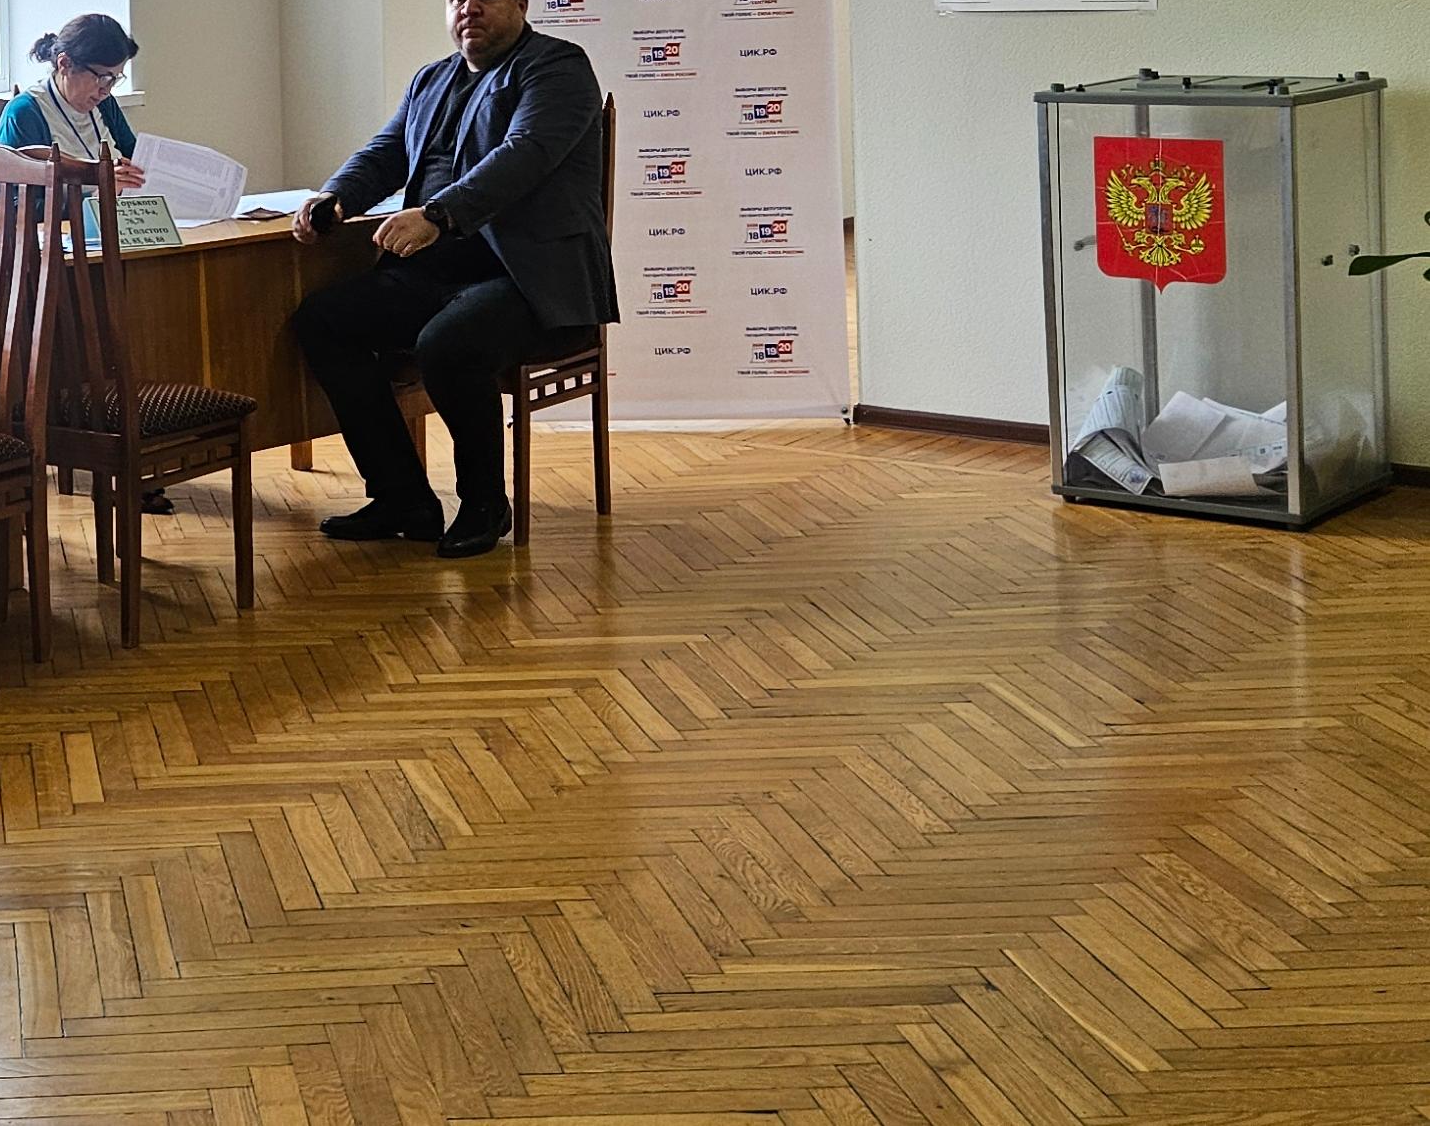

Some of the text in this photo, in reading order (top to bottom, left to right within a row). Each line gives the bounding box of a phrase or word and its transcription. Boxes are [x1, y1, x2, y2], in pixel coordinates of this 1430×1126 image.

[653, 50, 664, 58] 19
[665, 46, 678, 55] 20
[740, 48, 777, 57] ЦИК.РФ
[643, 109, 680, 118] ЦИК.РФ
[755, 108, 766, 116] 19
[767, 104, 780, 112] 20
[658, 168, 669, 177] 19
[671, 164, 683, 173] 20
[745, 167, 782, 176] ЦИК.РФ
[126, 227, 169, 235] Толстого
[648, 227, 685, 236] ЦИК.РФ
[761, 227, 771, 235] 19
[773, 223, 785, 232] 20
[664, 287, 675, 295] 19
[676, 283, 689, 292] 20
[750, 287, 788, 296] ЦИК.РФ
[654, 346, 691, 356] ЦИК.РФ
[766, 347, 777, 355] 19
[778, 343, 791, 351] 20
